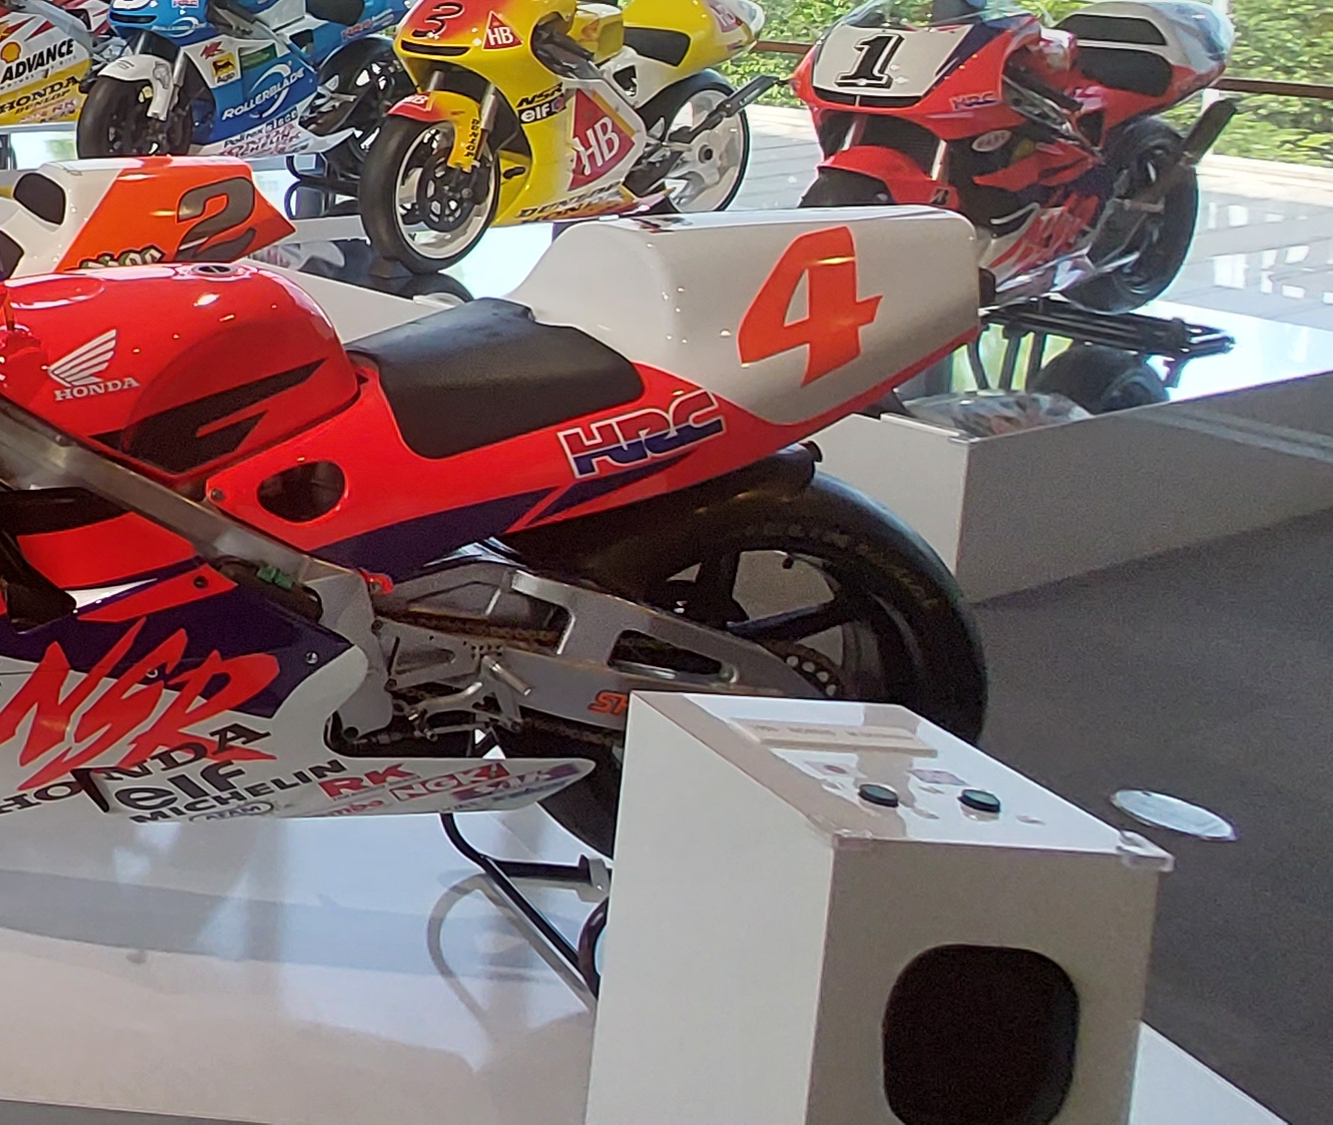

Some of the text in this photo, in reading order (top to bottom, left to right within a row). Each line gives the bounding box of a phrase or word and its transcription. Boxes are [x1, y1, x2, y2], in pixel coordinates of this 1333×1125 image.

[411, 2, 465, 40] 3
[487, 27, 514, 46] HB
[0, 38, 75, 85] ADVANCE
[835, 34, 904, 89] 1
[222, 67, 305, 120] ROLLERBLADE
[516, 82, 564, 108] NSR
[521, 105, 550, 123] elf
[573, 116, 621, 176] HB
[176, 176, 256, 262] 2
[737, 226, 884, 387] 4
[54, 376, 141, 401] HONDA
[558, 389, 725, 479] HRC
[114, 761, 247, 811] elf
[130, 759, 349, 823] MICHELIN
[318, 763, 415, 799] RK
